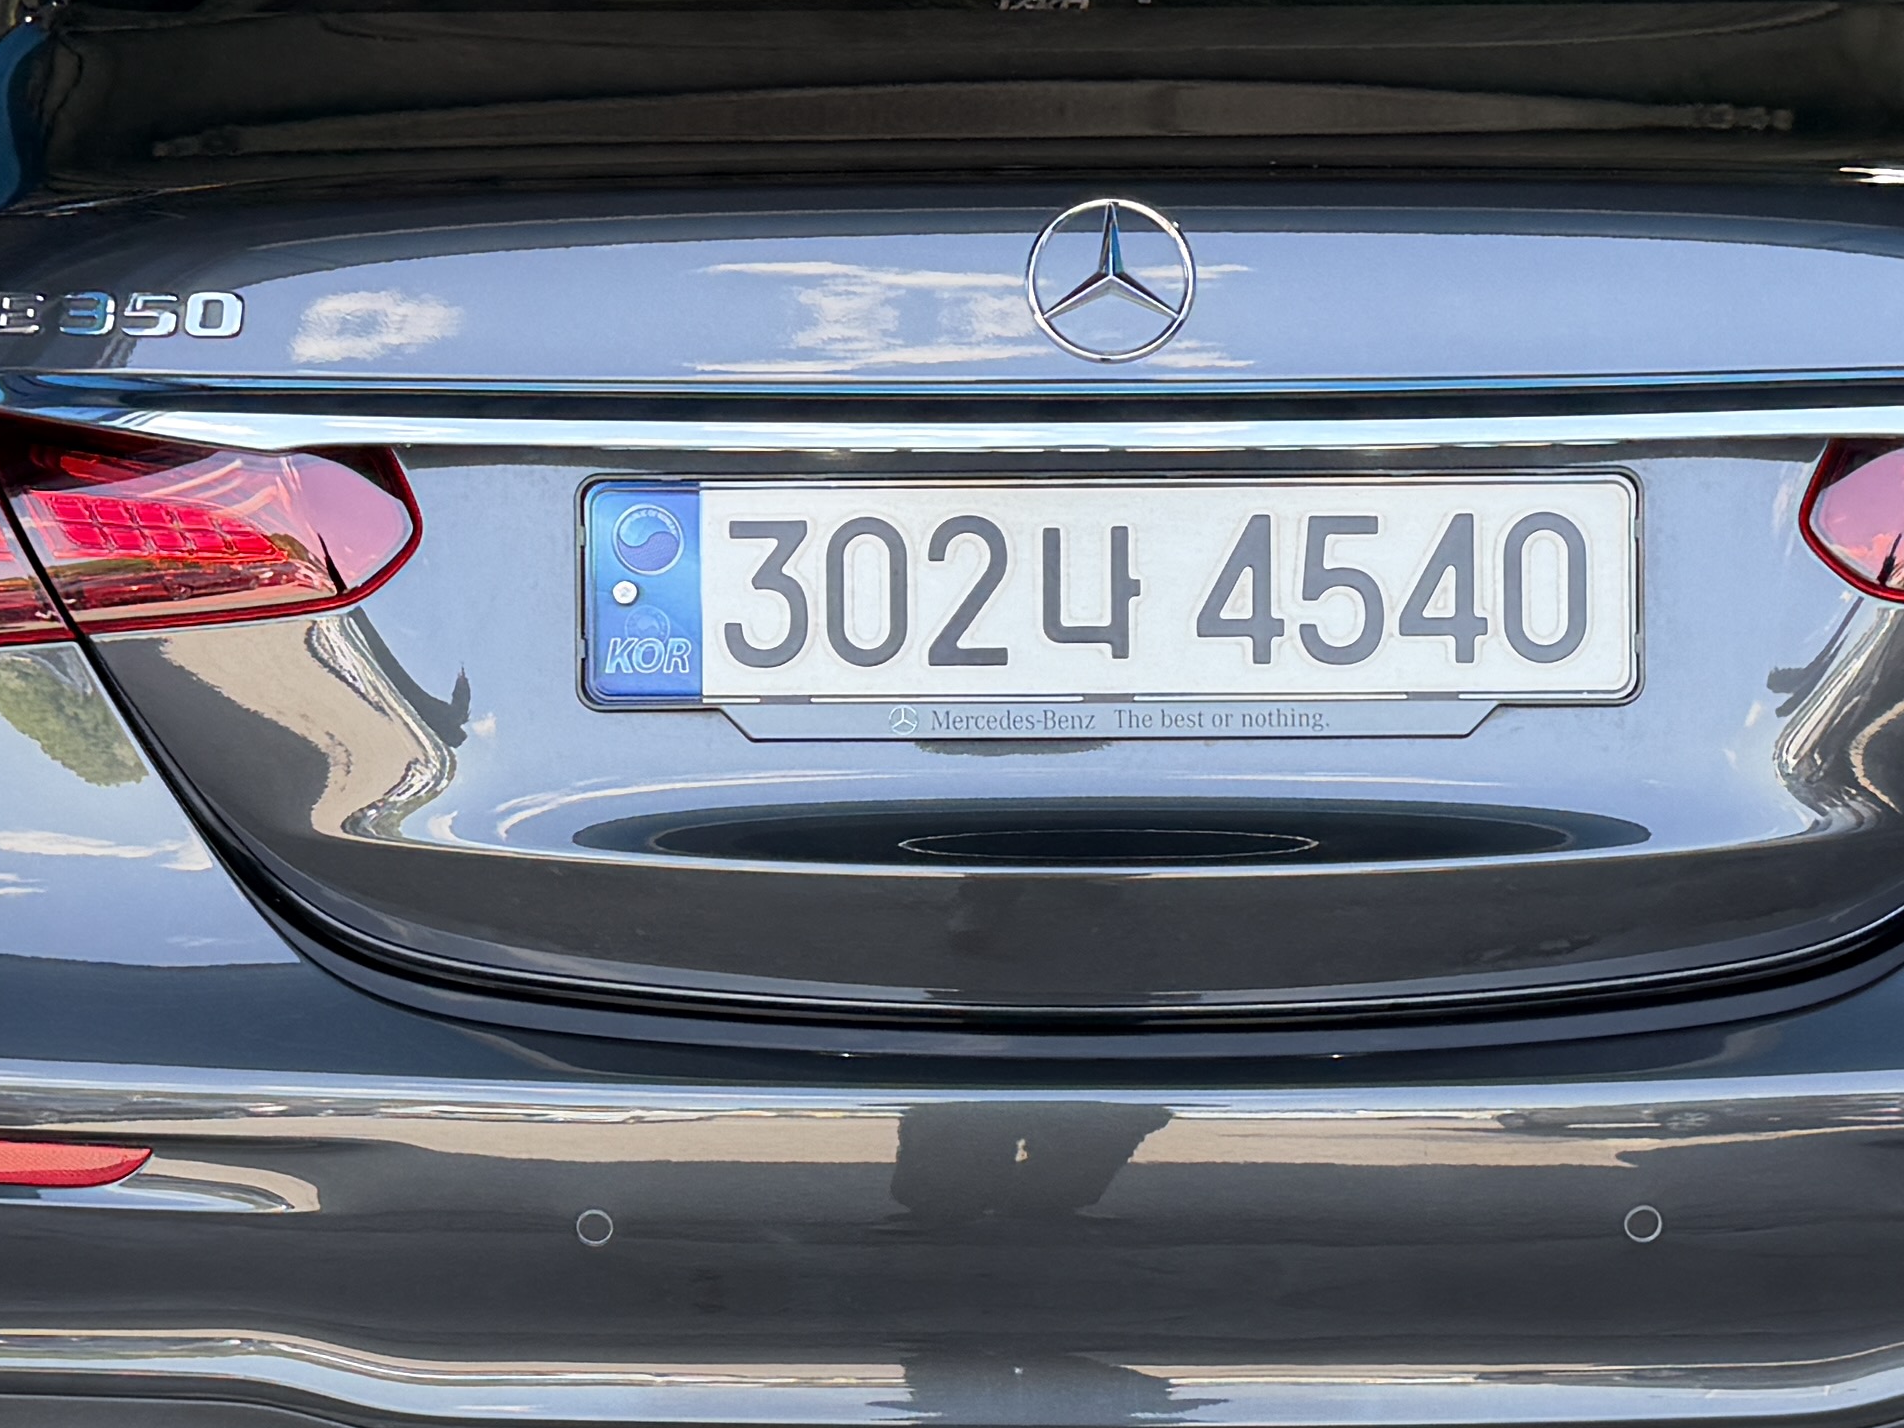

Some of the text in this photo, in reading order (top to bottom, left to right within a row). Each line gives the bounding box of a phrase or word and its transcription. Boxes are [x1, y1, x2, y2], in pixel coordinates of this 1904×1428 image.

[58, 290, 245, 339] 350
[724, 511, 1587, 668] 302나 4540
[604, 636, 693, 674] KOR
[931, 708, 1331, 732] Mercedes-Benz The best or nothing.
